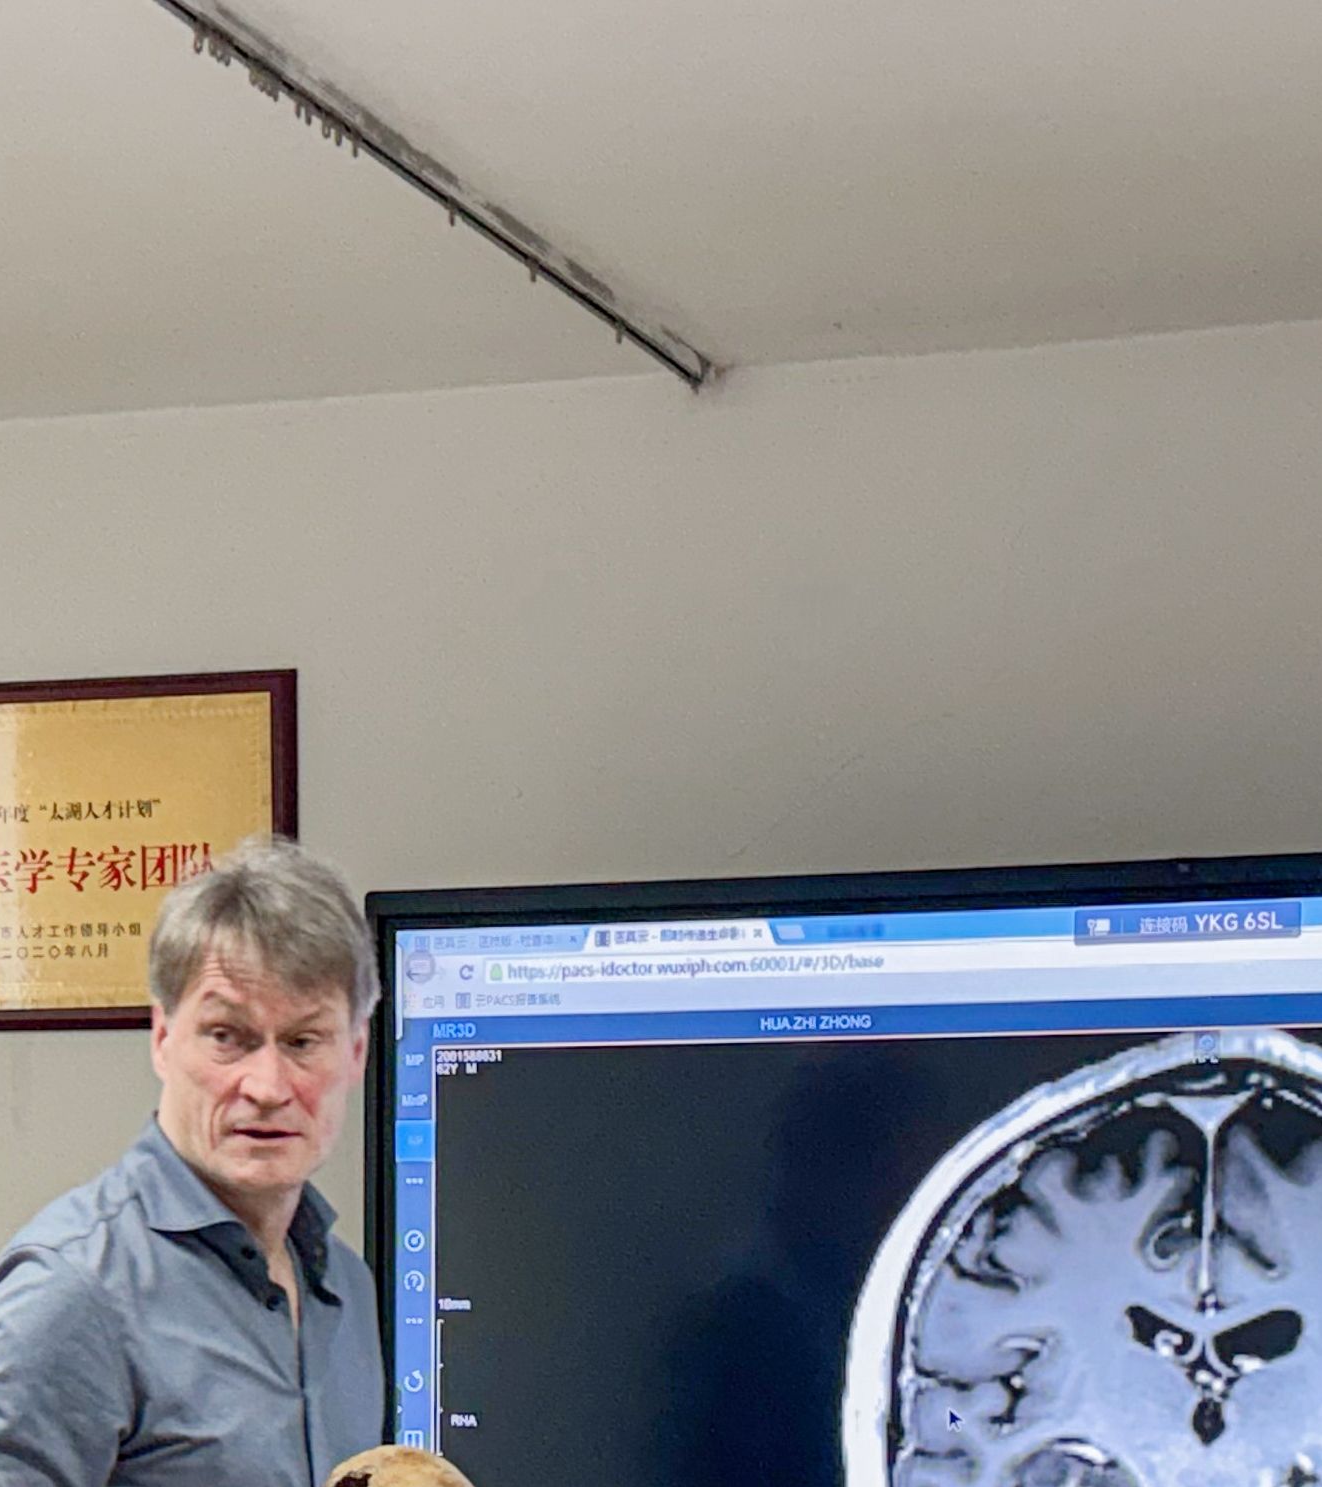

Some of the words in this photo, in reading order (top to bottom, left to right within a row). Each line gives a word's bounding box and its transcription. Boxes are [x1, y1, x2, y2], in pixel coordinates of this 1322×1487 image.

[1139, 915, 1188, 934] 连接码
[1194, 911, 1240, 933] YKG
[1243, 910, 1284, 931] 6SL
[819, 1013, 872, 1029] ZHONG
[433, 1023, 477, 1039] MR3D
[465, 1063, 478, 1075] M
